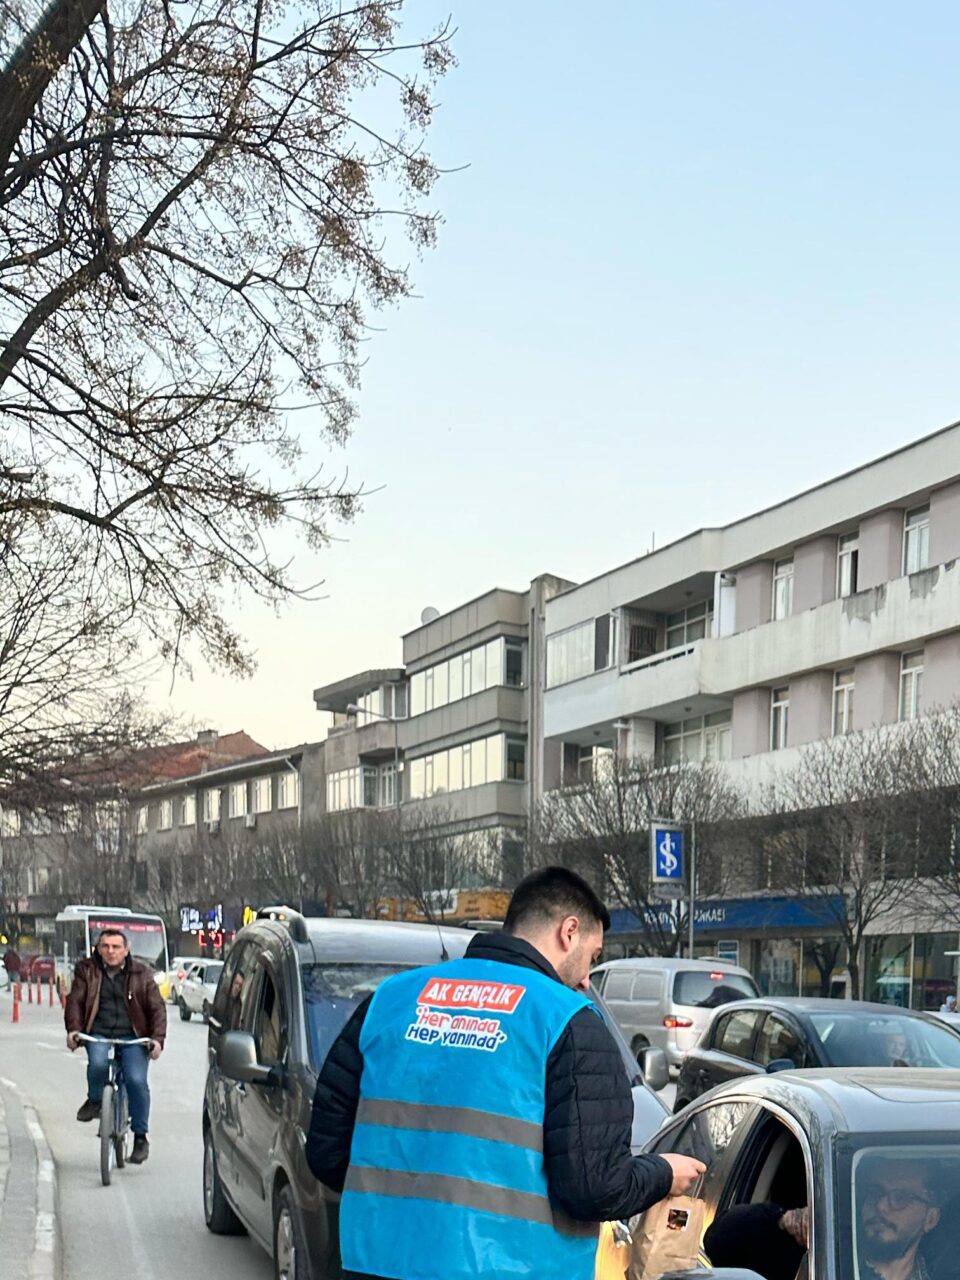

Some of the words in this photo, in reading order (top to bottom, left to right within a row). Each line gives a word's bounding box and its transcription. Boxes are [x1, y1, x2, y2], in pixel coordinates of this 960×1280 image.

[425, 982, 452, 1001] AK
[452, 984, 516, 1008] GENÇLİK
[451, 1017, 499, 1033] anında
